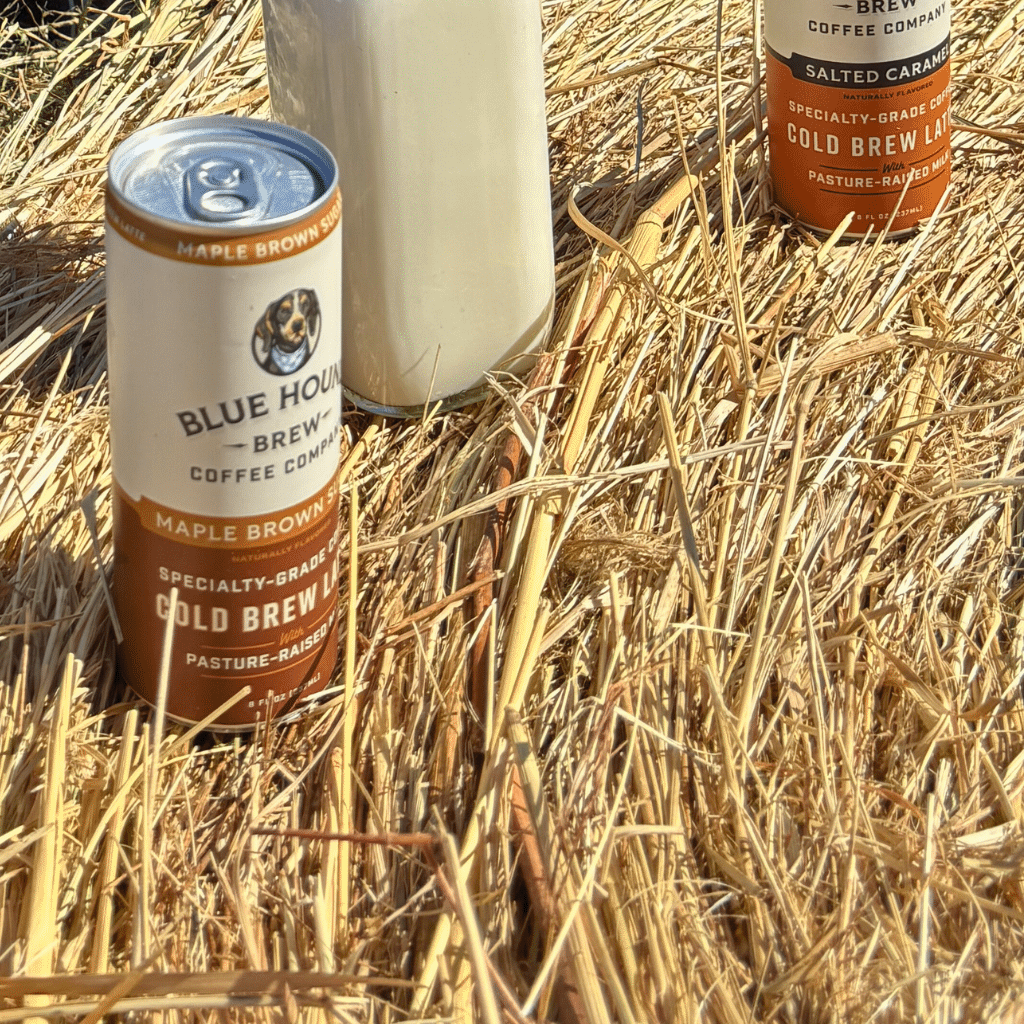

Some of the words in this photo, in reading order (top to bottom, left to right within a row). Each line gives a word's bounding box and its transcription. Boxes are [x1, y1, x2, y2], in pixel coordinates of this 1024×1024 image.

[808, 20, 876, 36] COFFEE
[884, 1, 946, 35] COMPANY
[806, 64, 879, 83] SALTED
[885, 43, 950, 81] CARAMEL
[788, 100, 926, 125] SPECIALTY-GRADE
[843, 92, 894, 101] NATURALLY
[787, 123, 839, 155] COLD
[851, 130, 917, 157] BREW
[925, 105, 951, 145] LATT
[882, 162, 905, 174] With
[878, 212, 889, 220] OZ
[177, 241, 248, 260] MAPLE
[255, 225, 320, 259] BROWN
[176, 392, 269, 437] BLUE
[279, 363, 342, 410] HOUN
[253, 411, 321, 453] BREW
[190, 465, 275, 483] COFFEE
[156, 512, 237, 542] MAPLE
[246, 496, 324, 542] BROWN
[159, 547, 326, 593] SPECIALTY-GRADE
[156, 593, 228, 633] COLD
[242, 582, 318, 633] BREW
[186, 623, 327, 670] PASTURE-RAISED
[279, 626, 305, 646] With
[274, 693, 286, 703] OZ
